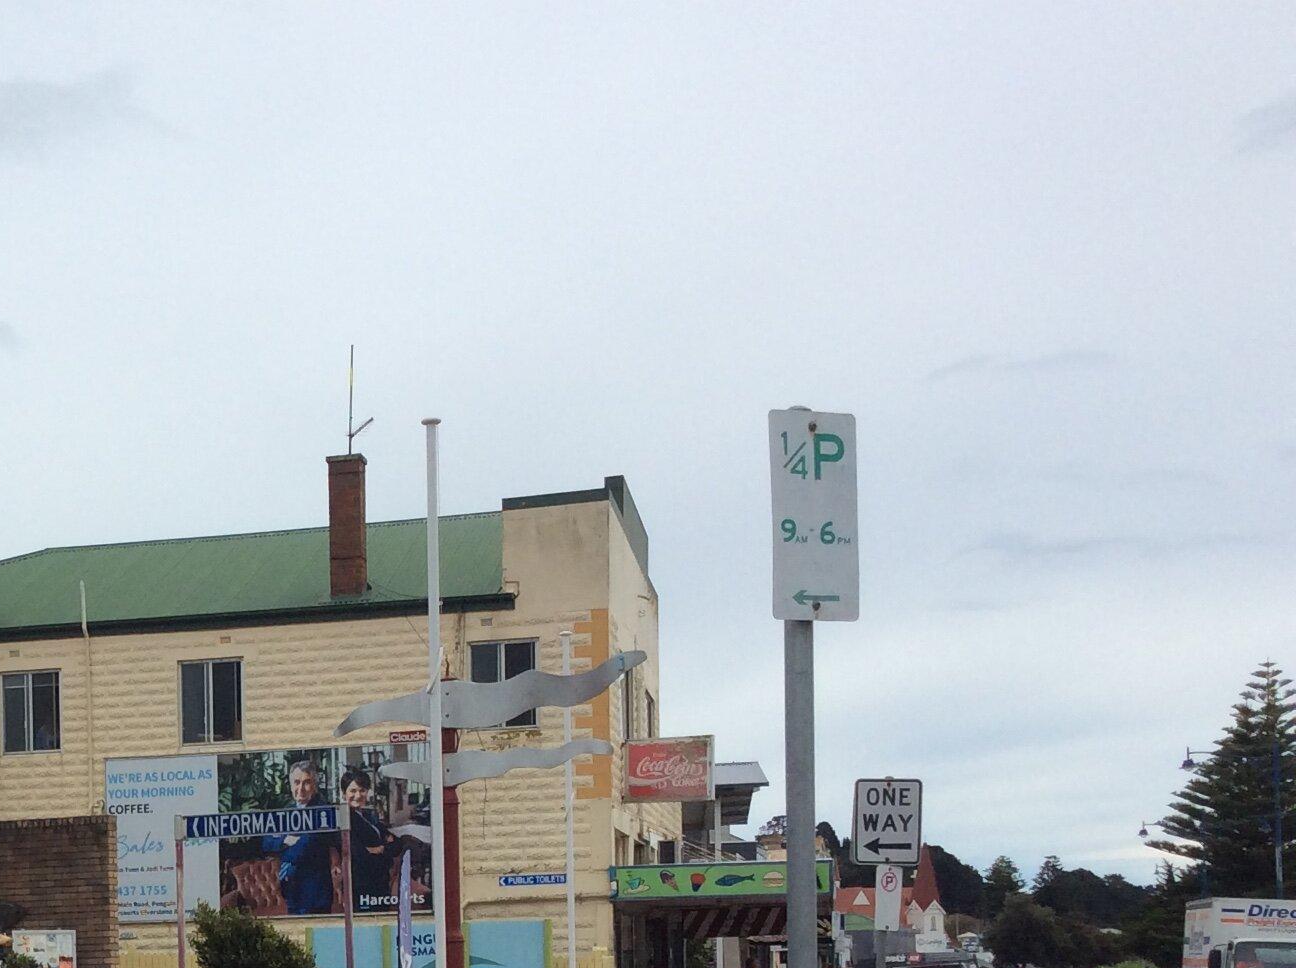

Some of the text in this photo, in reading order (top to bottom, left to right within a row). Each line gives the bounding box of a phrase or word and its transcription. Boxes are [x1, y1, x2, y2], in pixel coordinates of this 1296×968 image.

[390, 732, 426, 742] Claude
[108, 769, 213, 784] WE'RE AS LOCAL AS
[108, 785, 195, 799] YOUR MORNING
[866, 787, 911, 806] ONE
[108, 803, 154, 815] COFFEE.
[203, 809, 314, 837] INFORMATION
[862, 813, 913, 832] WAY
[507, 874, 565, 885] PUBLIC TOILETS
[139, 885, 167, 896] 1755
